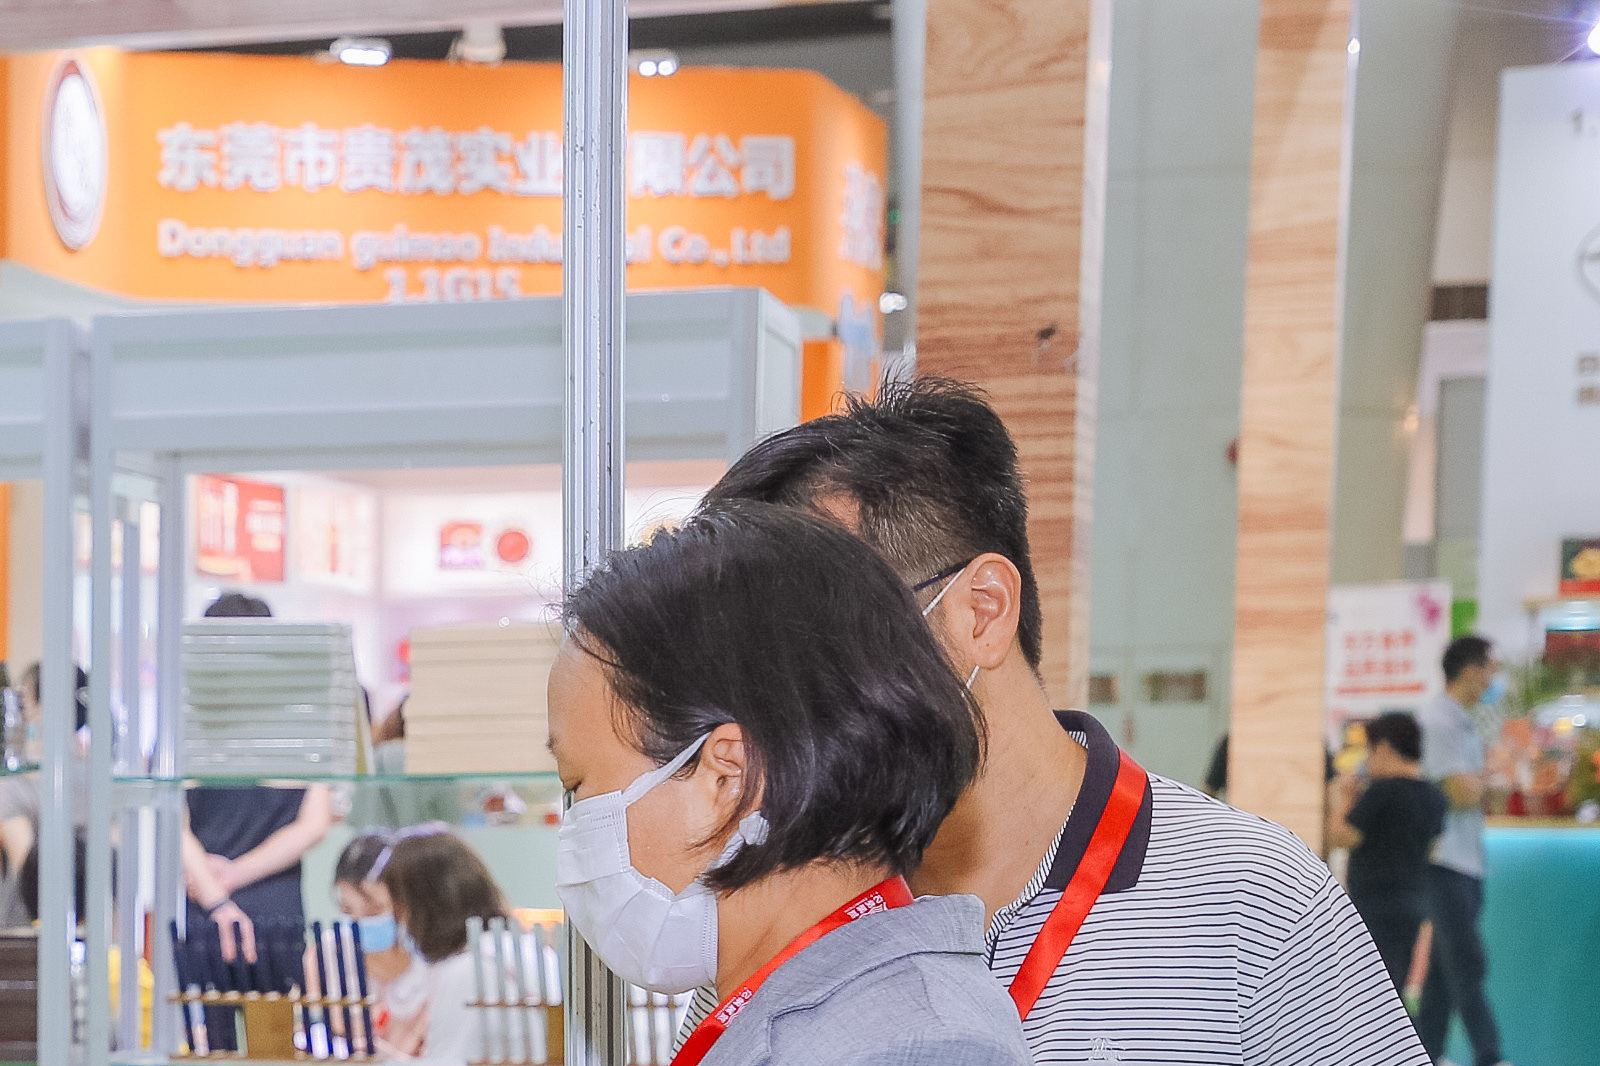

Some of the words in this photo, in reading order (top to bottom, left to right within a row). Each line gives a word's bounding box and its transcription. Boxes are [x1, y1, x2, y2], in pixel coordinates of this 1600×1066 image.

[157, 122, 797, 200] 东莞市贵茂实业限公司
